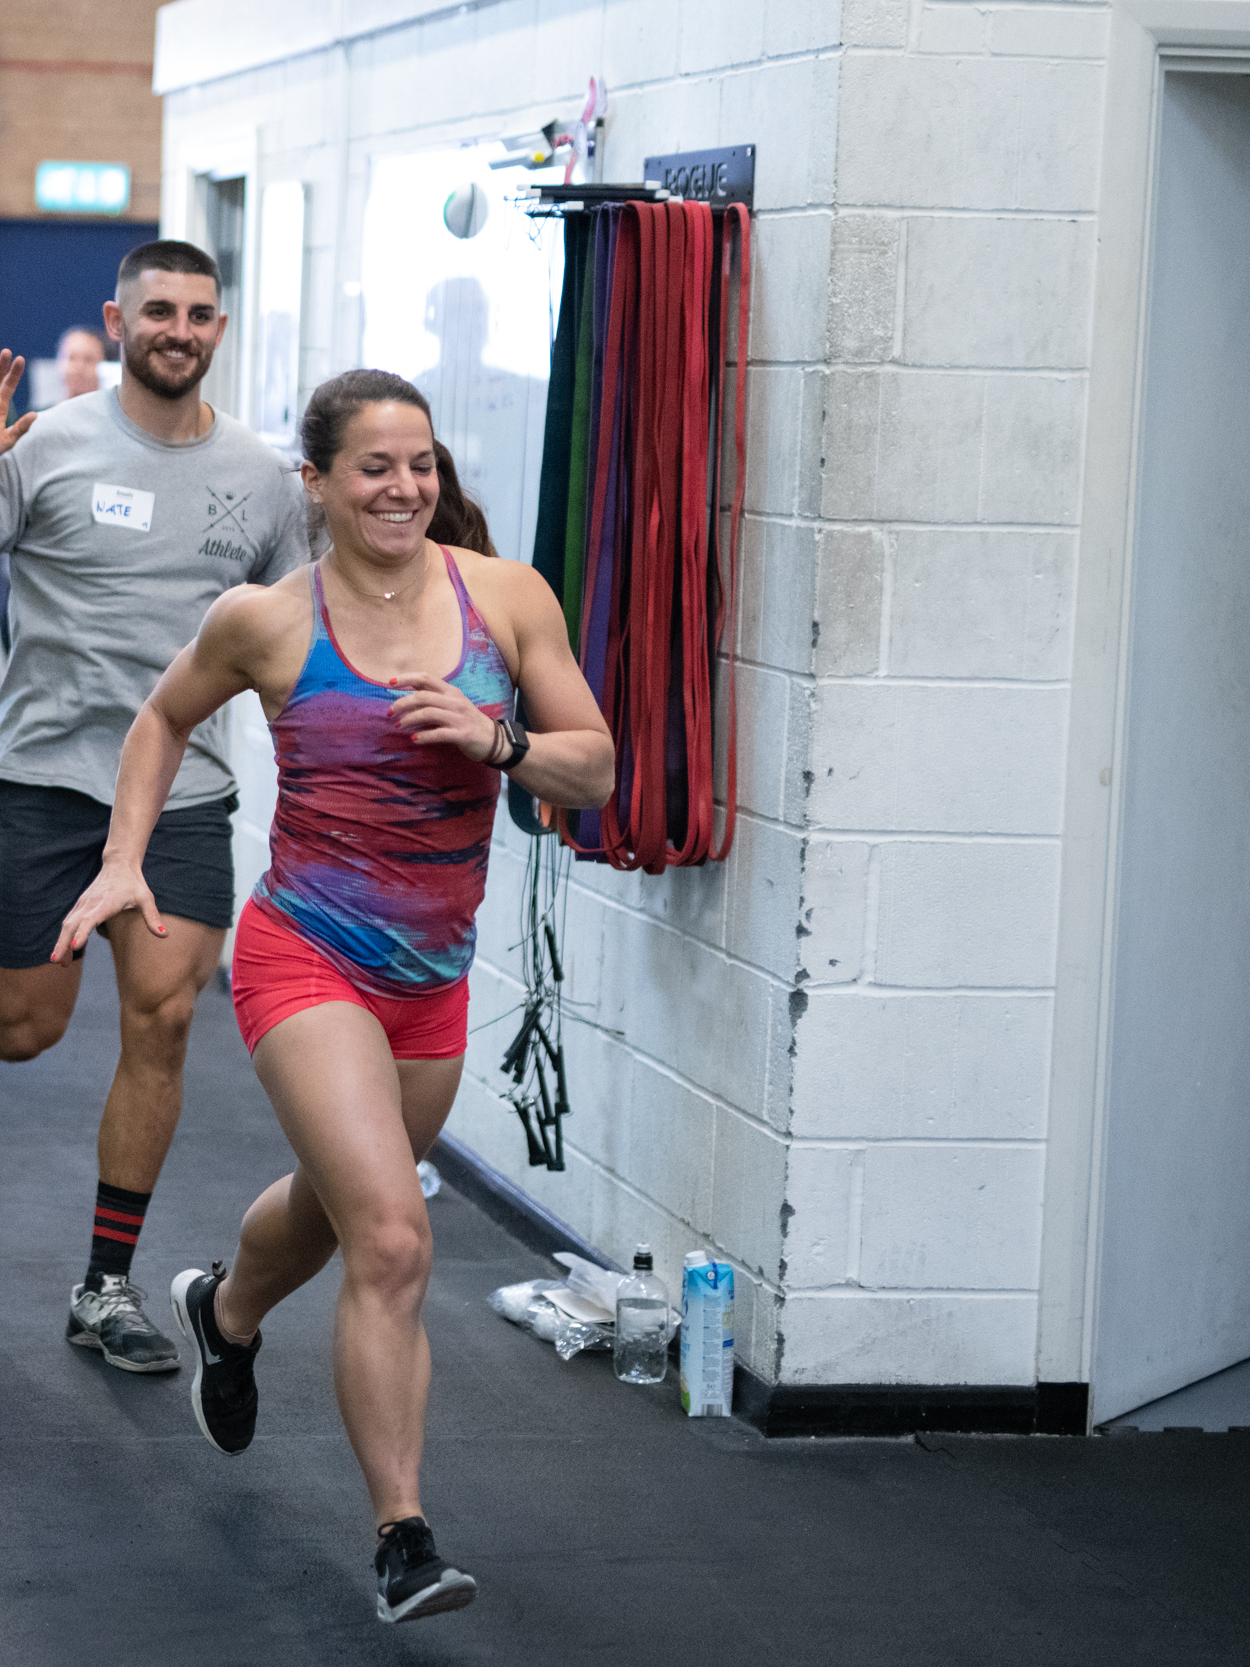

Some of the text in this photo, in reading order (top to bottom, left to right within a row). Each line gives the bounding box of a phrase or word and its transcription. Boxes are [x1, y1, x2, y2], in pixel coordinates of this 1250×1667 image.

[665, 162, 728, 199] ROGUE
[96, 500, 131, 517] NATE
[198, 538, 248, 562] Athlete
